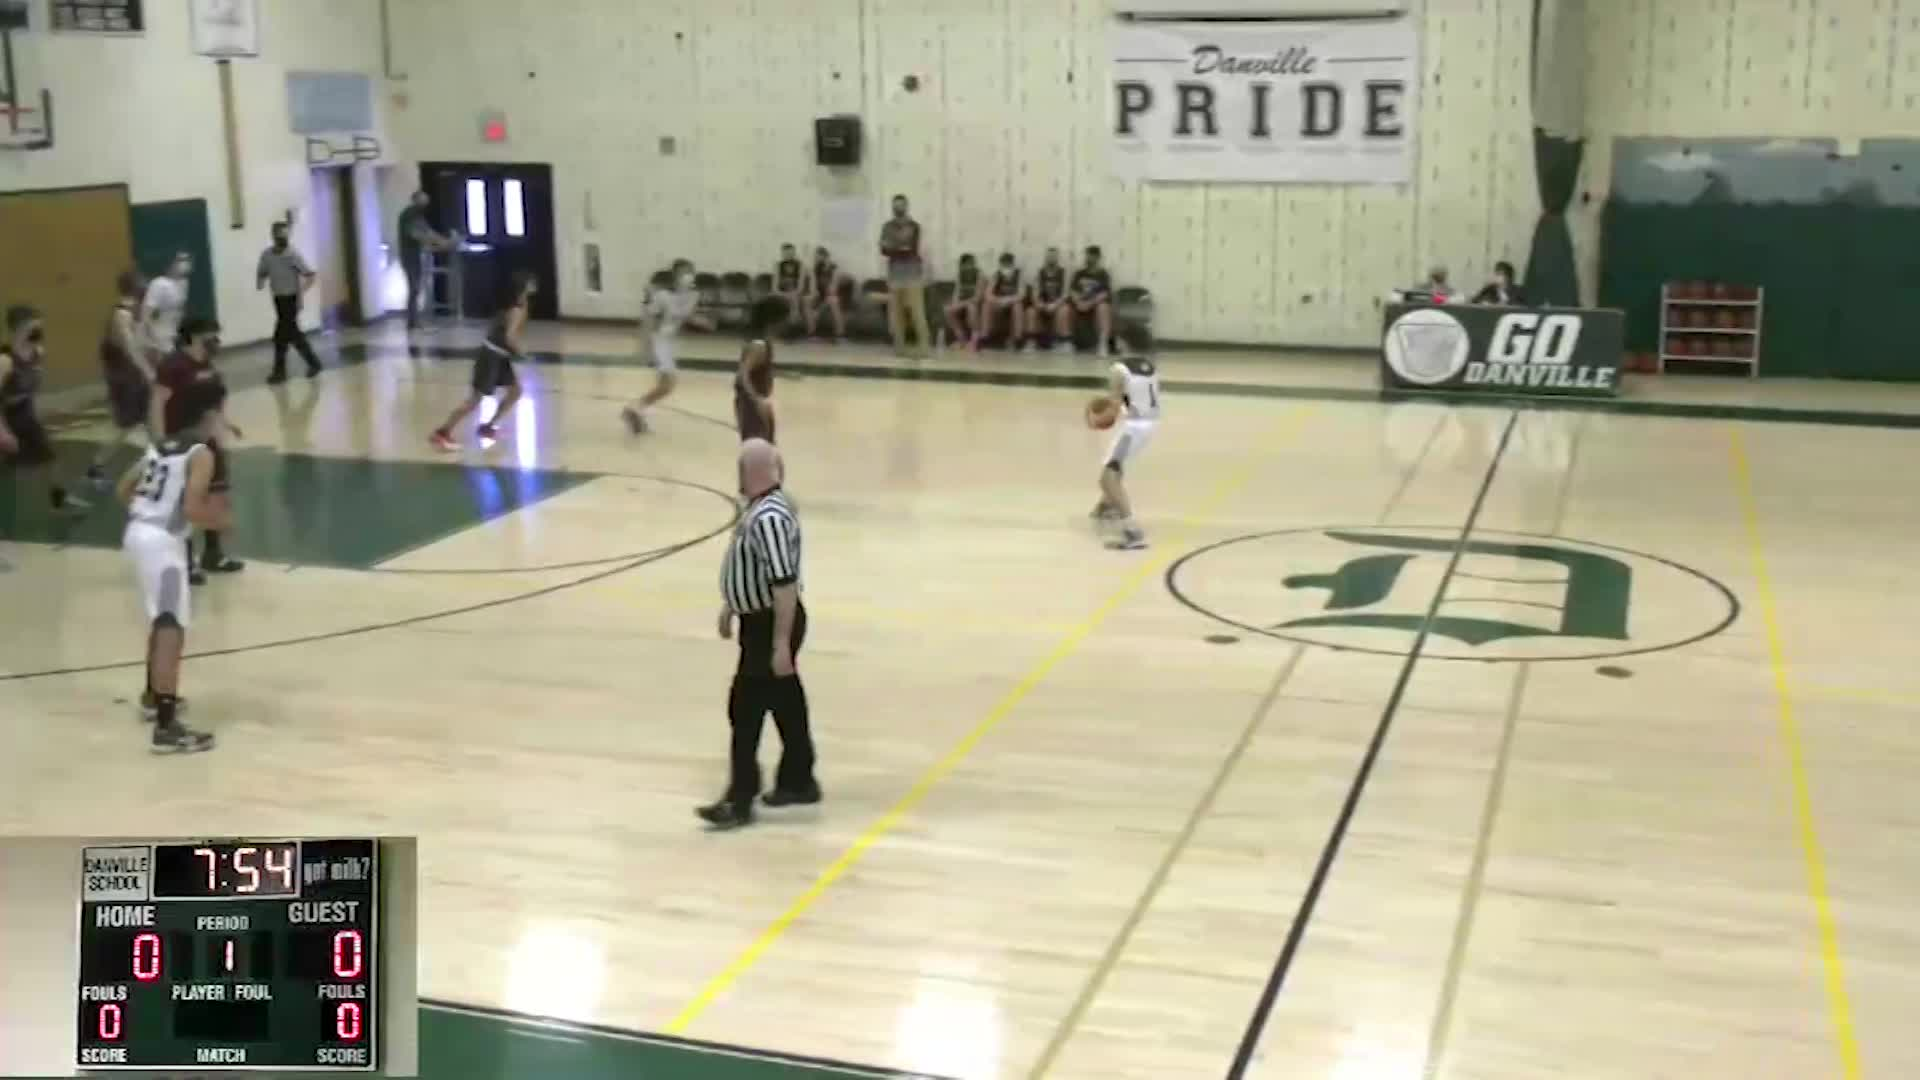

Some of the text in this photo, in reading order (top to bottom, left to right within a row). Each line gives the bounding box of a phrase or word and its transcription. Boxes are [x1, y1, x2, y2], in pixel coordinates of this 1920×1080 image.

[1191, 44, 1318, 75] Danville
[1114, 79, 1406, 138] PRIDE
[1487, 312, 1582, 366] GO
[1464, 361, 1617, 388] DANVILLE
